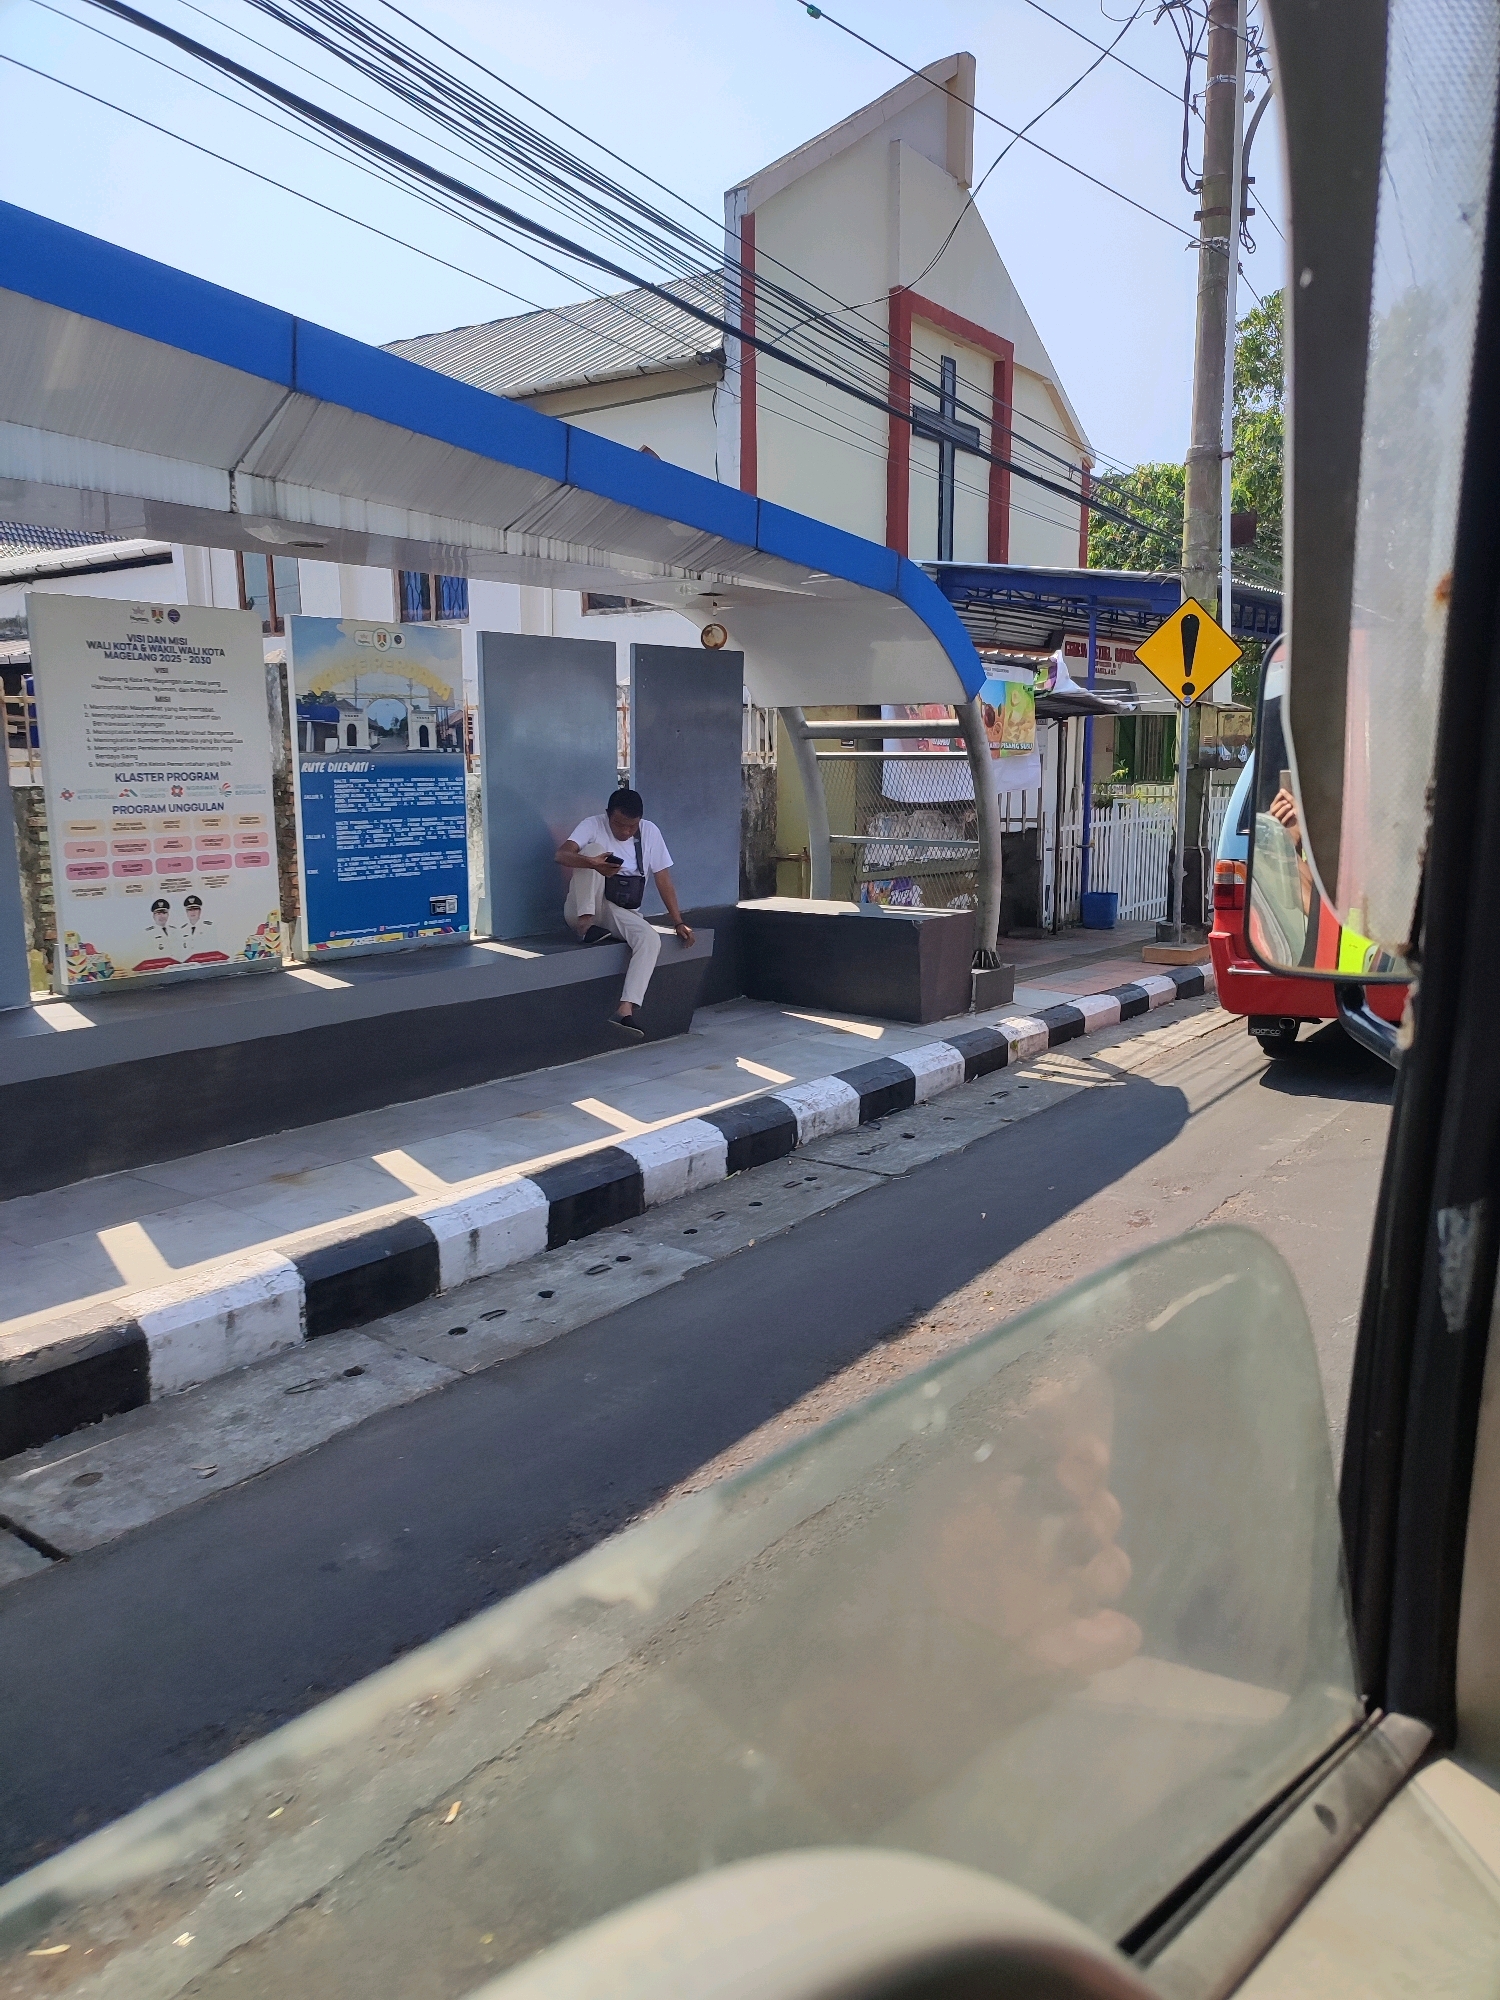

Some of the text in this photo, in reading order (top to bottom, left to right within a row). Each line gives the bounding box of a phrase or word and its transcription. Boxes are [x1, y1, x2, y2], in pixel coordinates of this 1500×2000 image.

[126, 634, 187, 645] VISI DAN MISI
[86, 640, 225, 657] WALI KOTA & WAKIL WALI KOTA
[104, 651, 157, 662] MAGELANG
[159, 654, 182, 663] 2025
[190, 656, 211, 664] 2030
[301, 762, 326, 773] RUTE
[327, 761, 369, 773] DILEWATI
[115, 772, 219, 782] KLASTER PROGRAM
[112, 802, 225, 814] PROGRAM UNGGULAN
